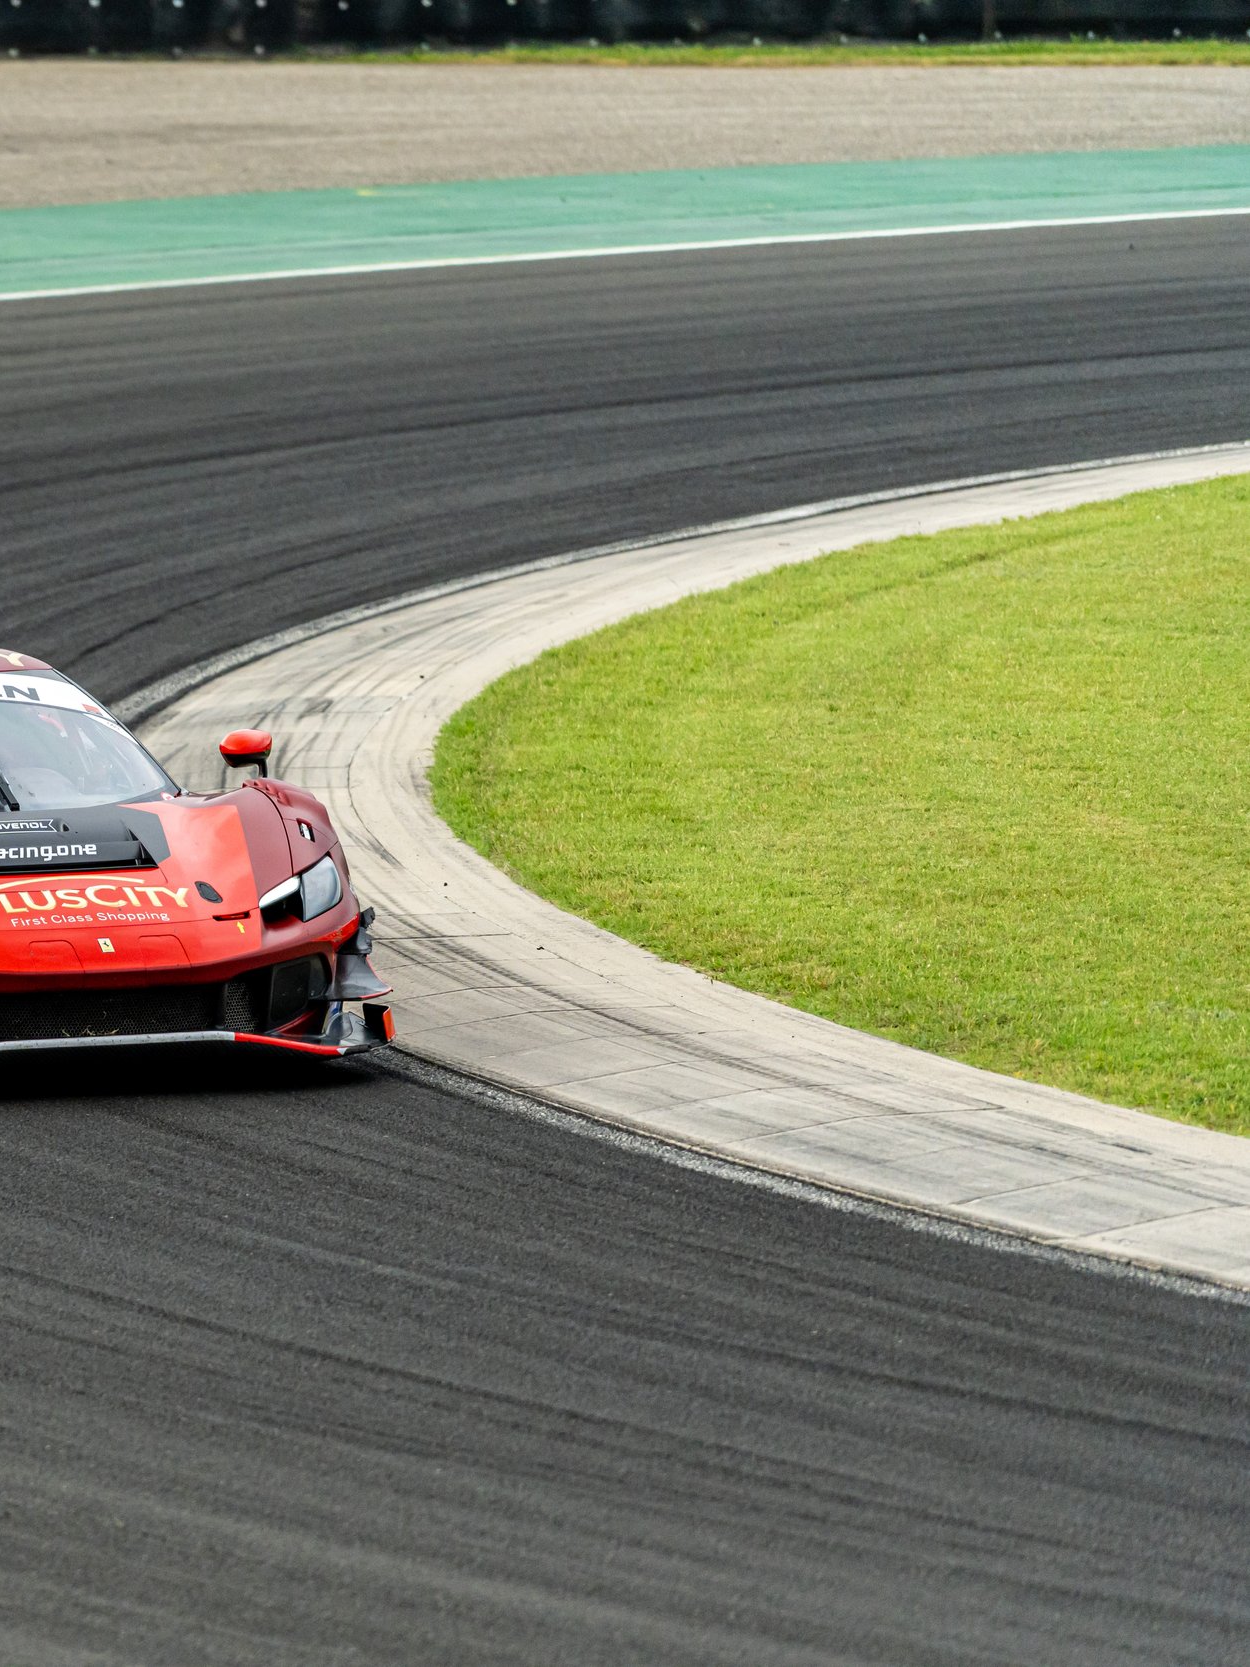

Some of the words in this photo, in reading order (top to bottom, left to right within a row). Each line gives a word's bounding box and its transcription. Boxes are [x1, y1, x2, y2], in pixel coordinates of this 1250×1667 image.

[10, 918, 49, 928] First
[50, 914, 94, 926] Class
[96, 911, 171, 922] Shopping
